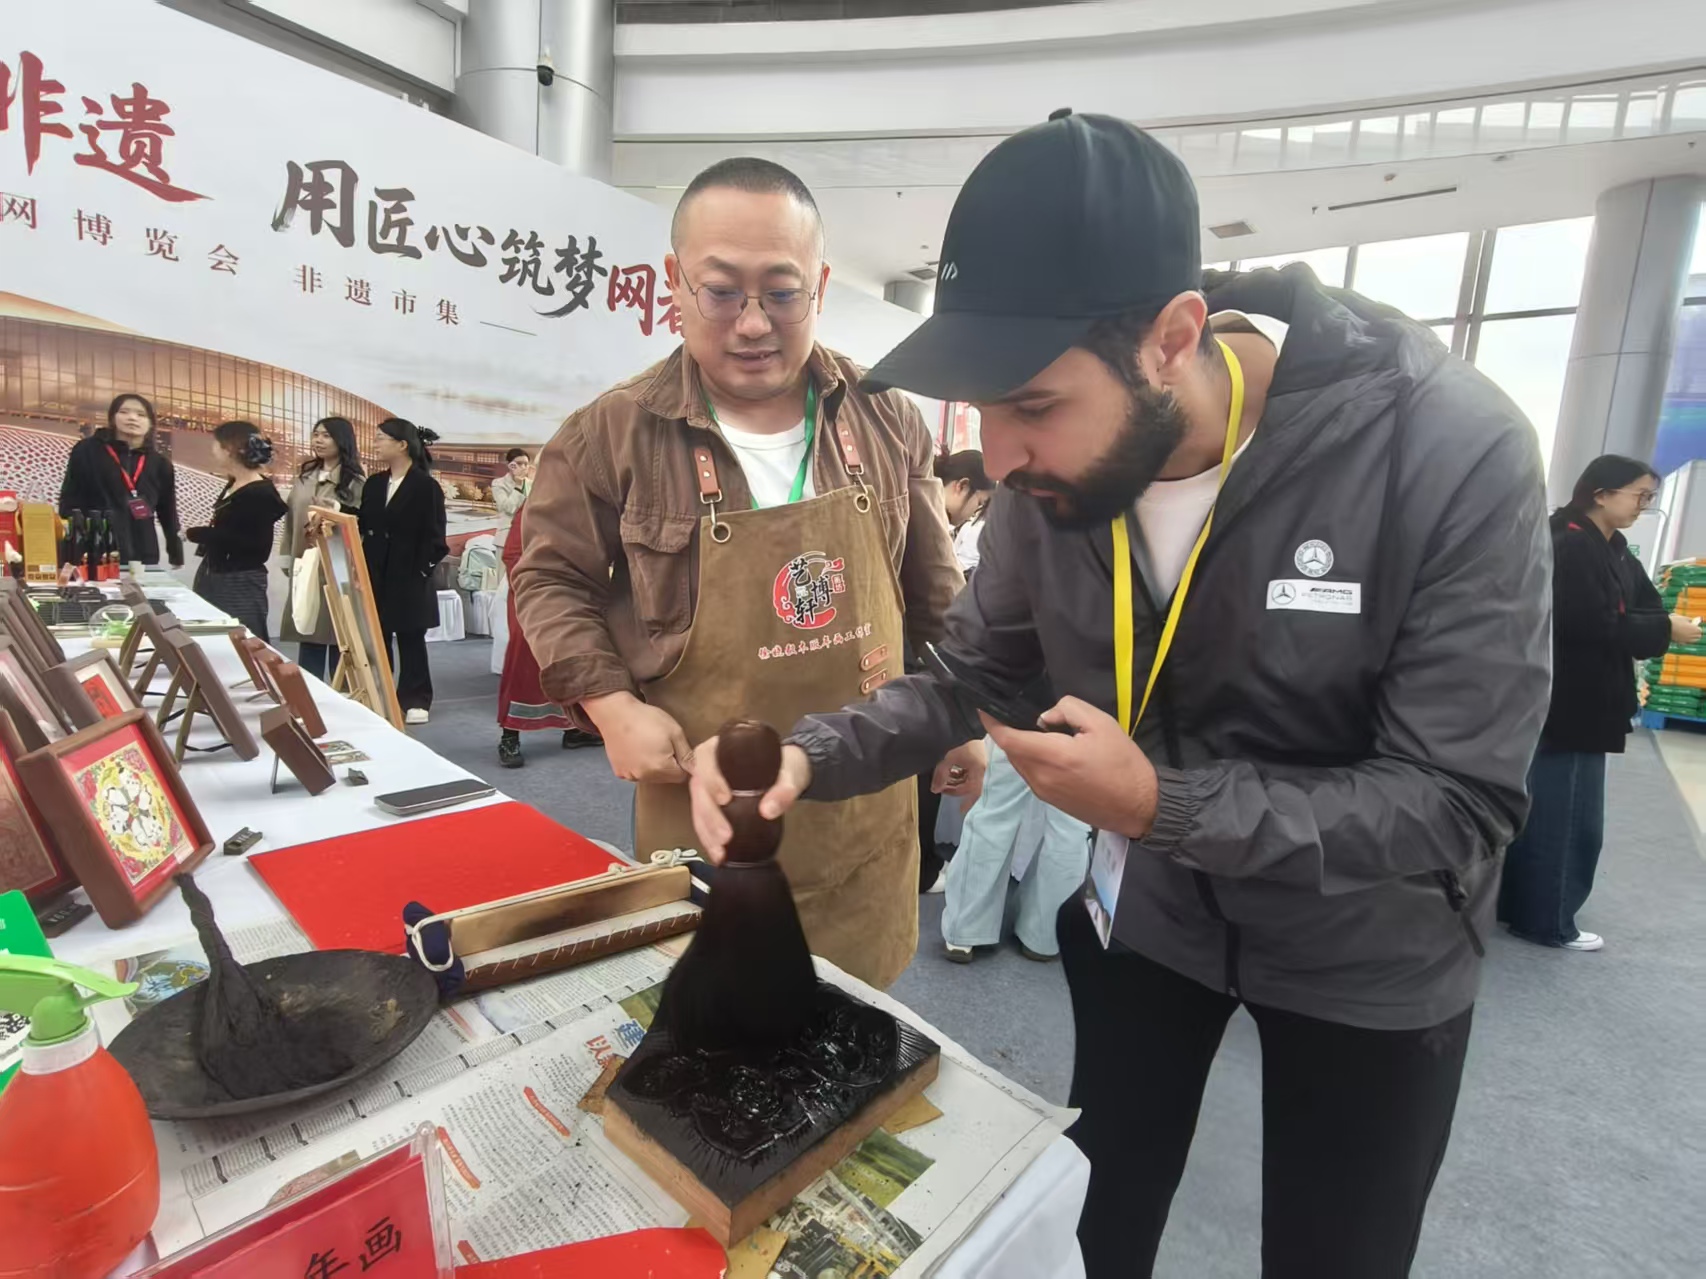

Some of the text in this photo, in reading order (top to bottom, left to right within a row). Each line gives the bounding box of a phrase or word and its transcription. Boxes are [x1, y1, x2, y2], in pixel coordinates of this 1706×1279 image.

[0, 50, 214, 203] 非遗
[0, 191, 462, 327] 网博览会 非遗市集
[303, 1216, 402, 1279] 年画
